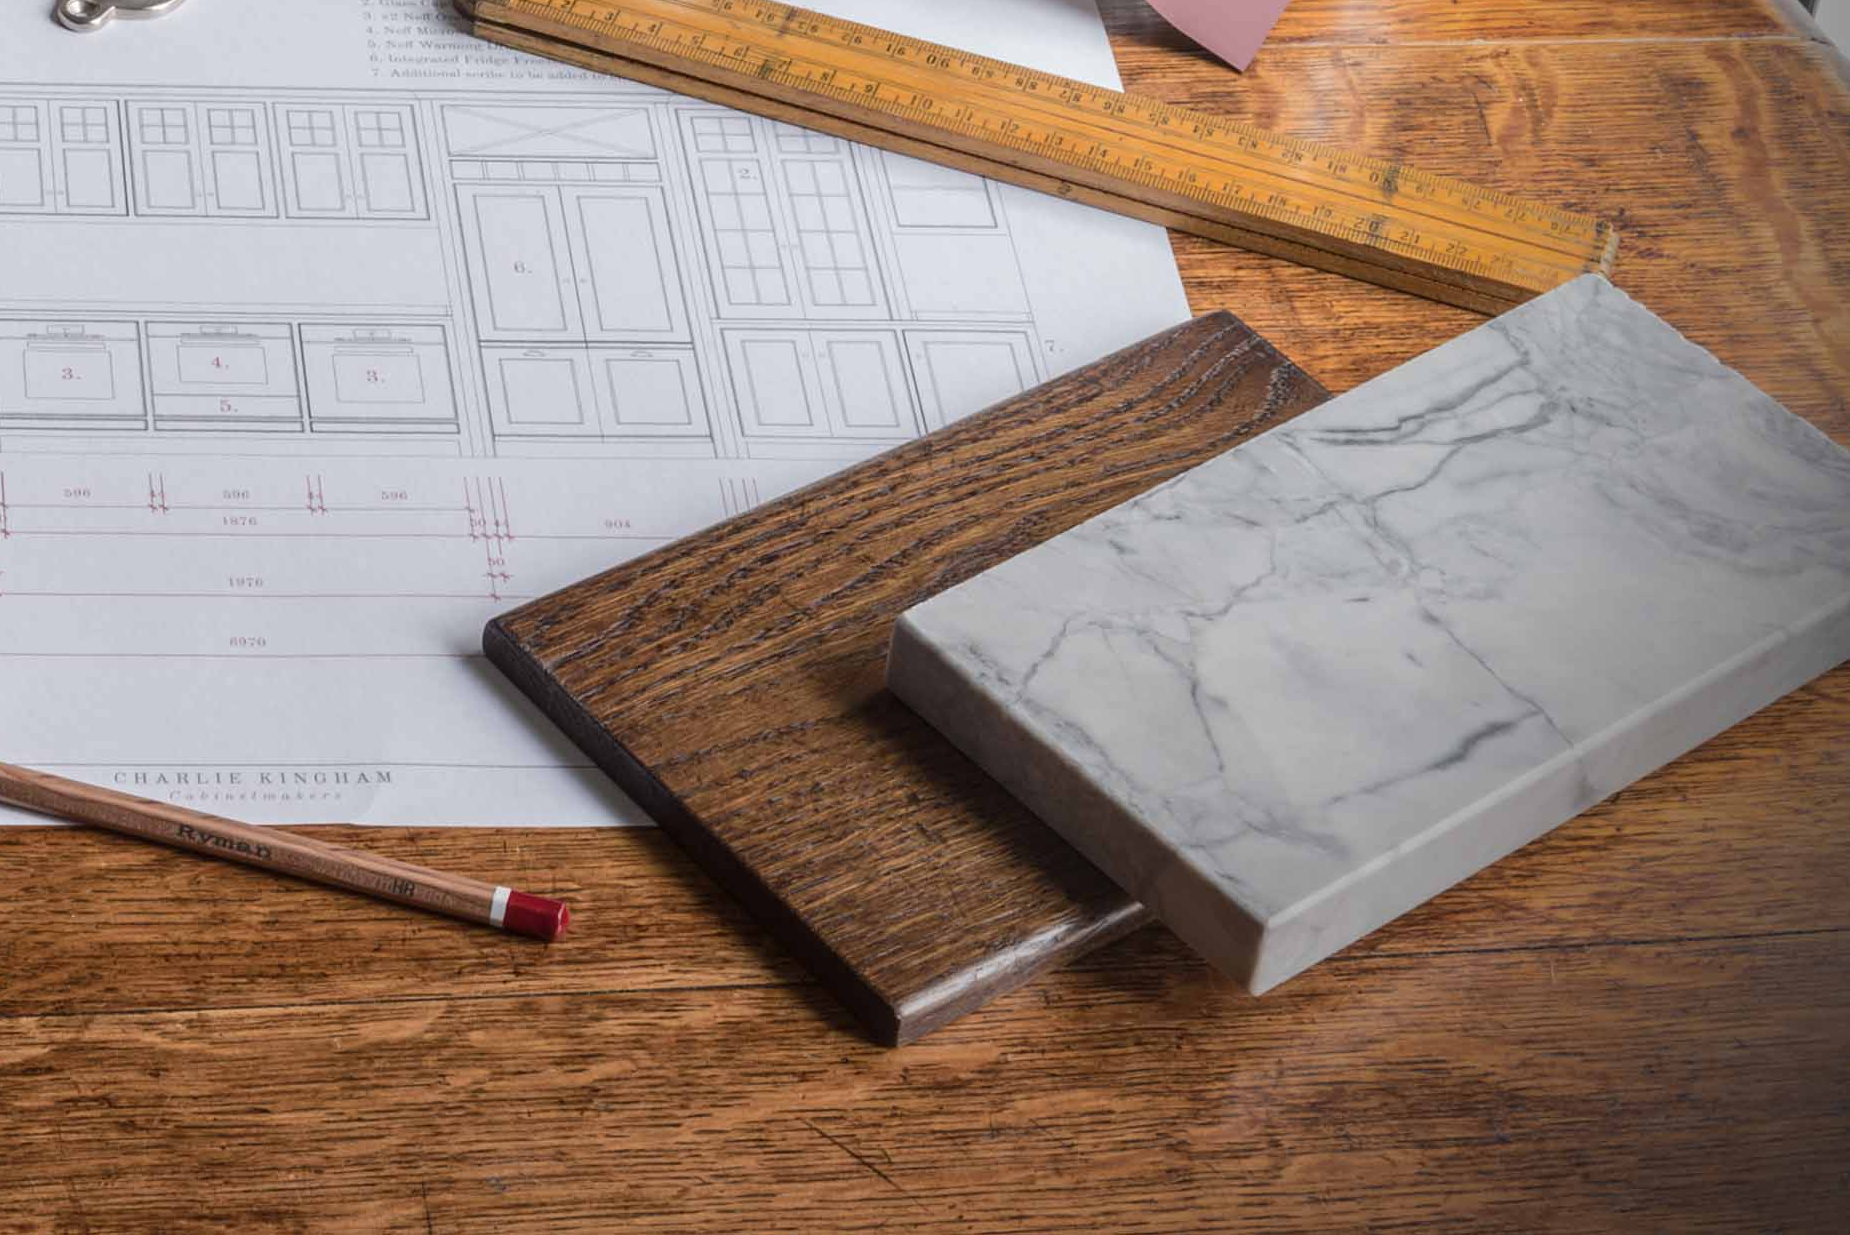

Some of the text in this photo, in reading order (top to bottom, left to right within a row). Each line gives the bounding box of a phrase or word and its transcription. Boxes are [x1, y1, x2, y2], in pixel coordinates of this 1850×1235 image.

[113, 770, 393, 785] CHARLIE KINGHAM
[168, 790, 343, 802] Cabinetmakers
[176, 823, 272, 861] Ryman
